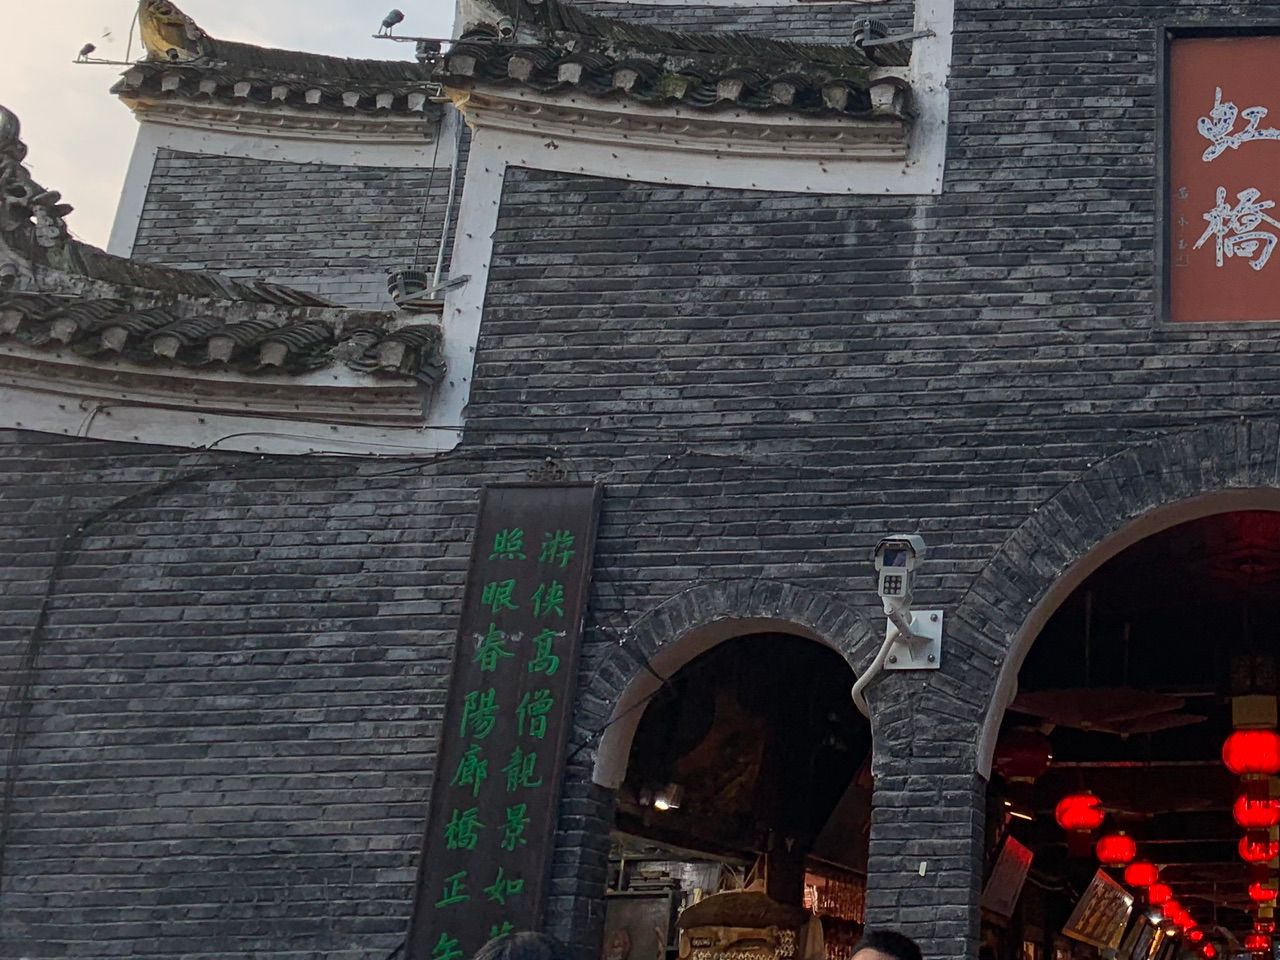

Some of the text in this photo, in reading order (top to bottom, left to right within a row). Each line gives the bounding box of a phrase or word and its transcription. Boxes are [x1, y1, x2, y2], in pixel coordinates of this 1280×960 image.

[483, 529, 576, 941] 游俠高僧靚景如
